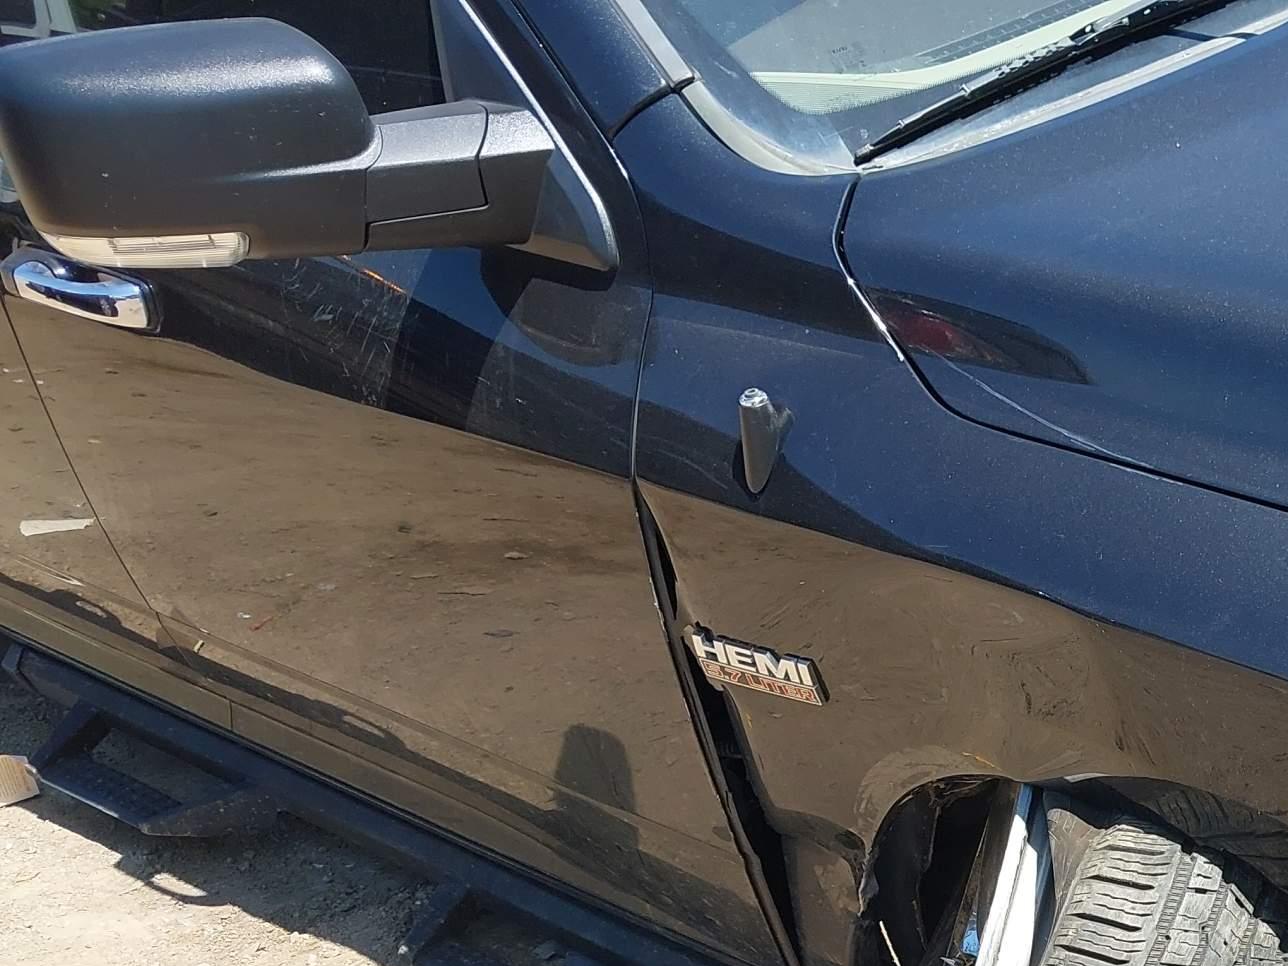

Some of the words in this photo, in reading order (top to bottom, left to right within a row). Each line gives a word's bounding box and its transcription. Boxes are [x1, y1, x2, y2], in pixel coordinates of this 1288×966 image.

[692, 633, 814, 686] HEMI
[704, 661, 741, 684] 5.7
[745, 673, 816, 701] LITER
